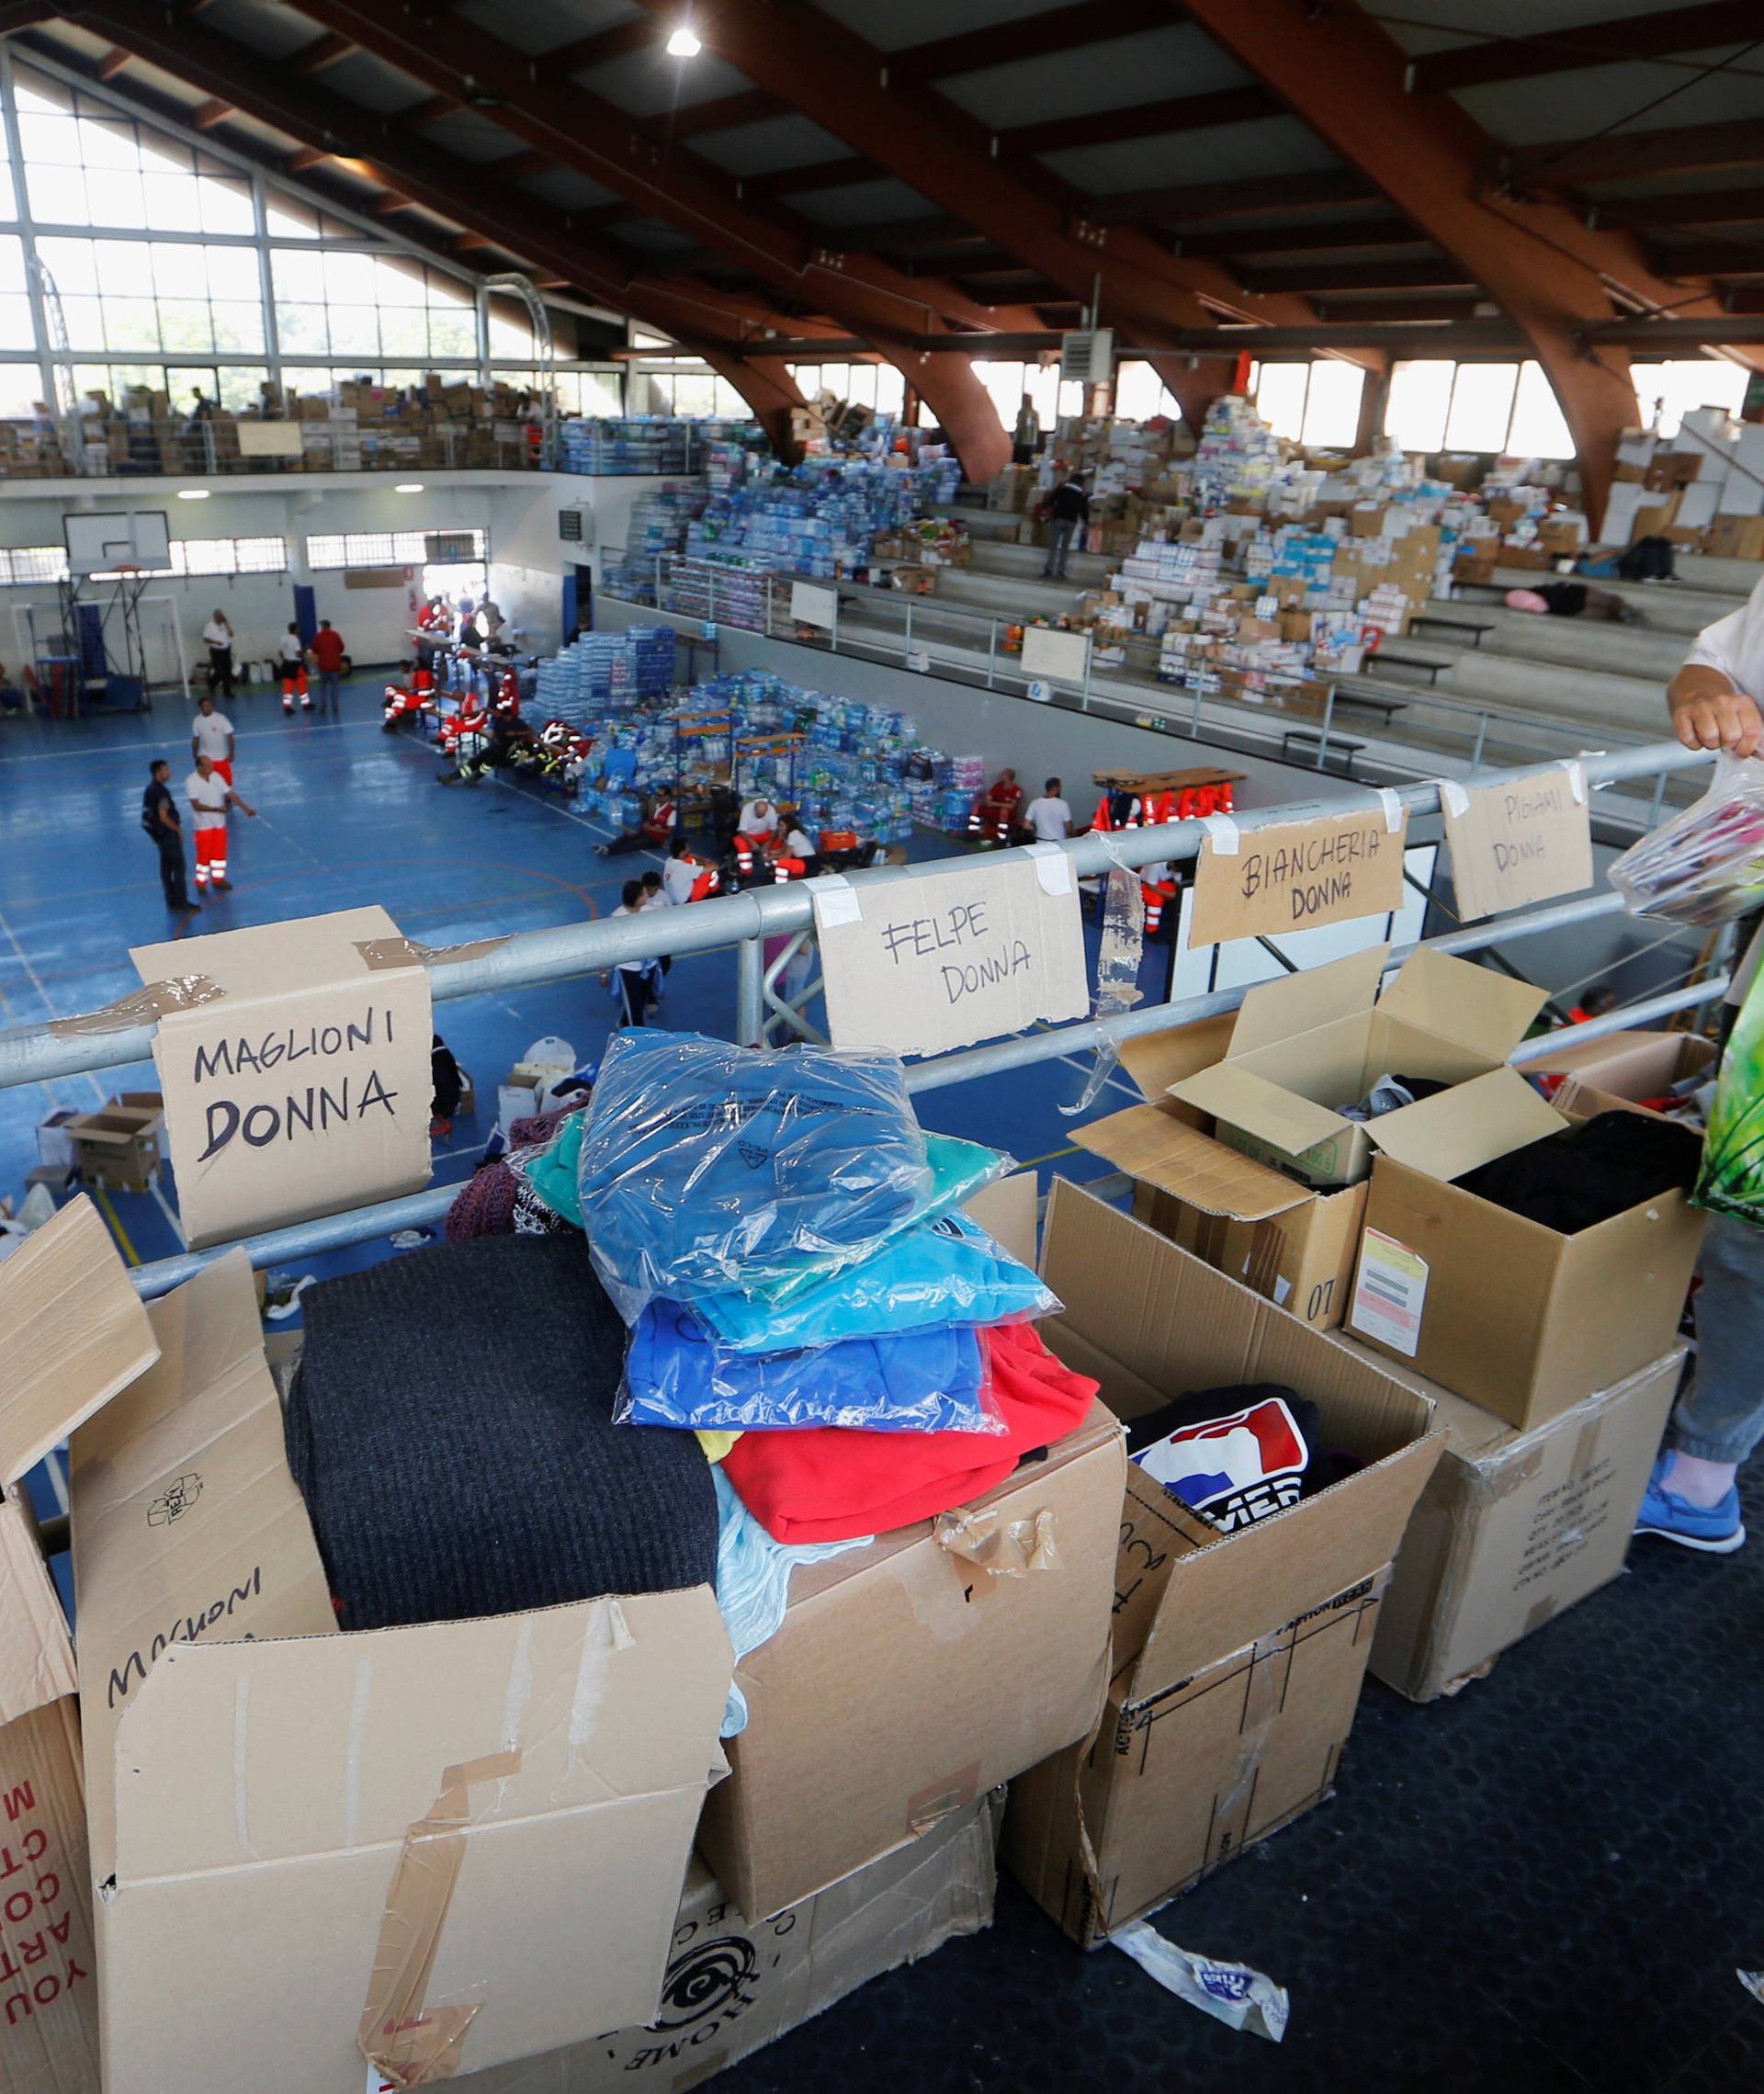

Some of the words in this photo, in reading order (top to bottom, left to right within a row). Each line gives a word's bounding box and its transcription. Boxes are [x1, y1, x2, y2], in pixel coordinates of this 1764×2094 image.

[1242, 830, 1380, 899] BIANCHERIA
[1493, 835, 1545, 872] DONNA
[1292, 872, 1351, 920] DONNA
[882, 900, 989, 965] FELPE
[941, 940, 1031, 1003] DONNA
[194, 1006, 393, 1083] MAGLIONI
[197, 1070, 399, 1162] DONNA
[1307, 1279, 1335, 1321] 07
[624, 1993, 757, 2071] HOME
